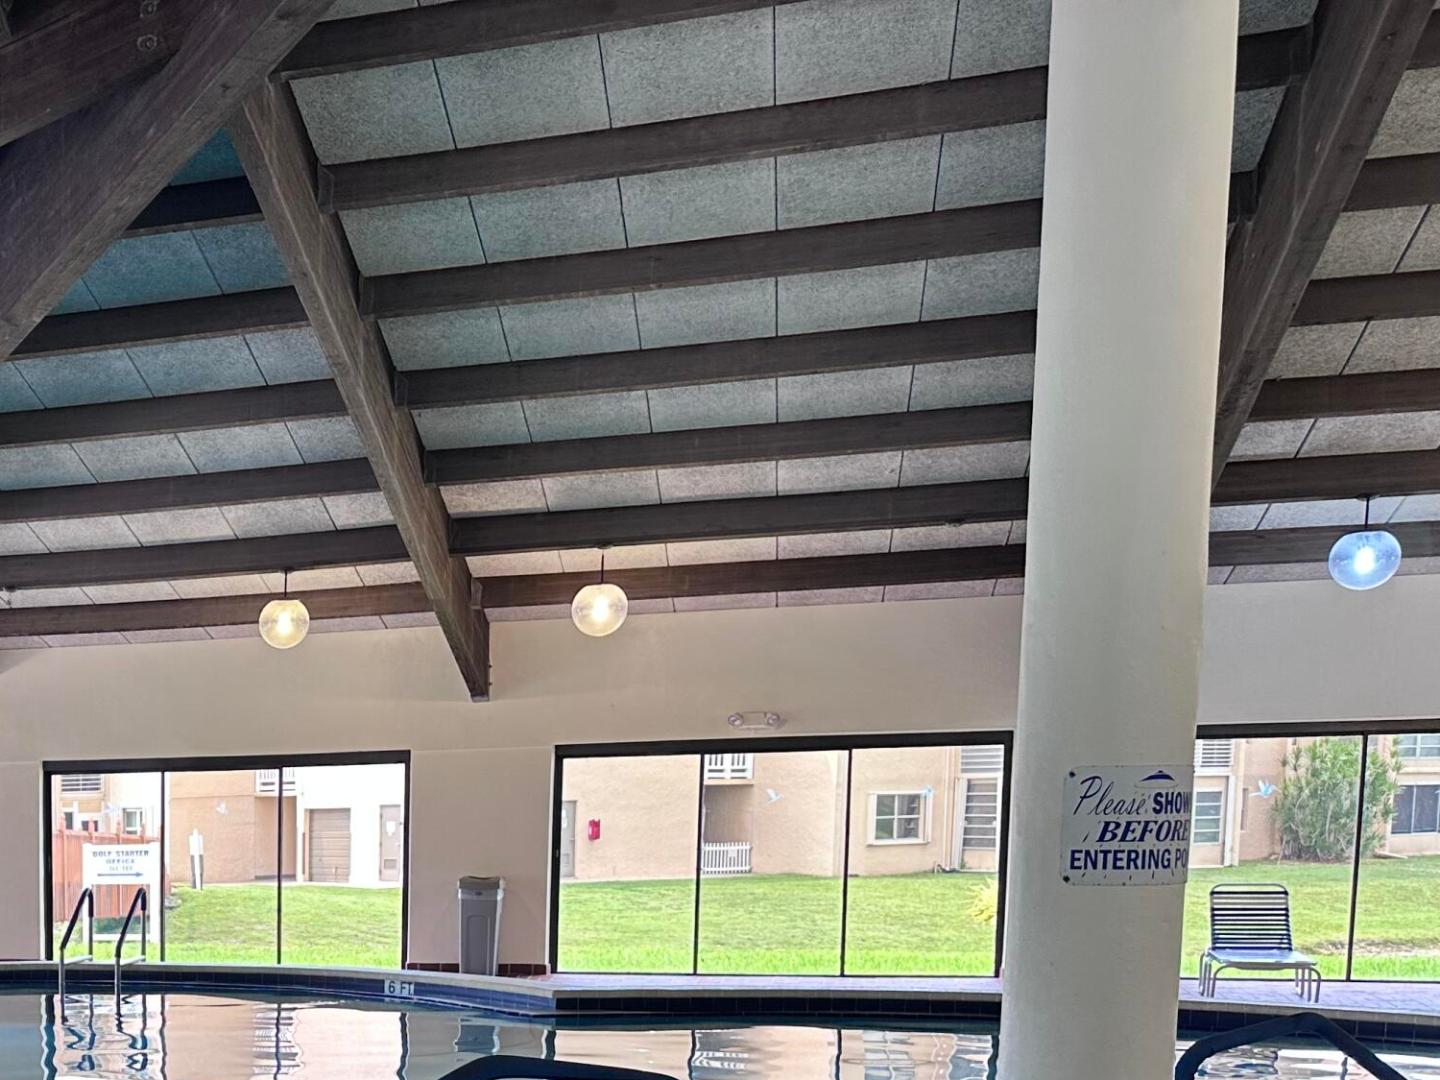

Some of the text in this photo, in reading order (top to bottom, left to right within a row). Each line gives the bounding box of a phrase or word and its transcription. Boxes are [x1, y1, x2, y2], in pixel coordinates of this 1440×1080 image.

[1073, 775, 1146, 815] Please
[1096, 820, 1189, 842] BEFORE
[1070, 849, 1171, 870] ENTERING
[388, 981, 414, 994] 6 FT
